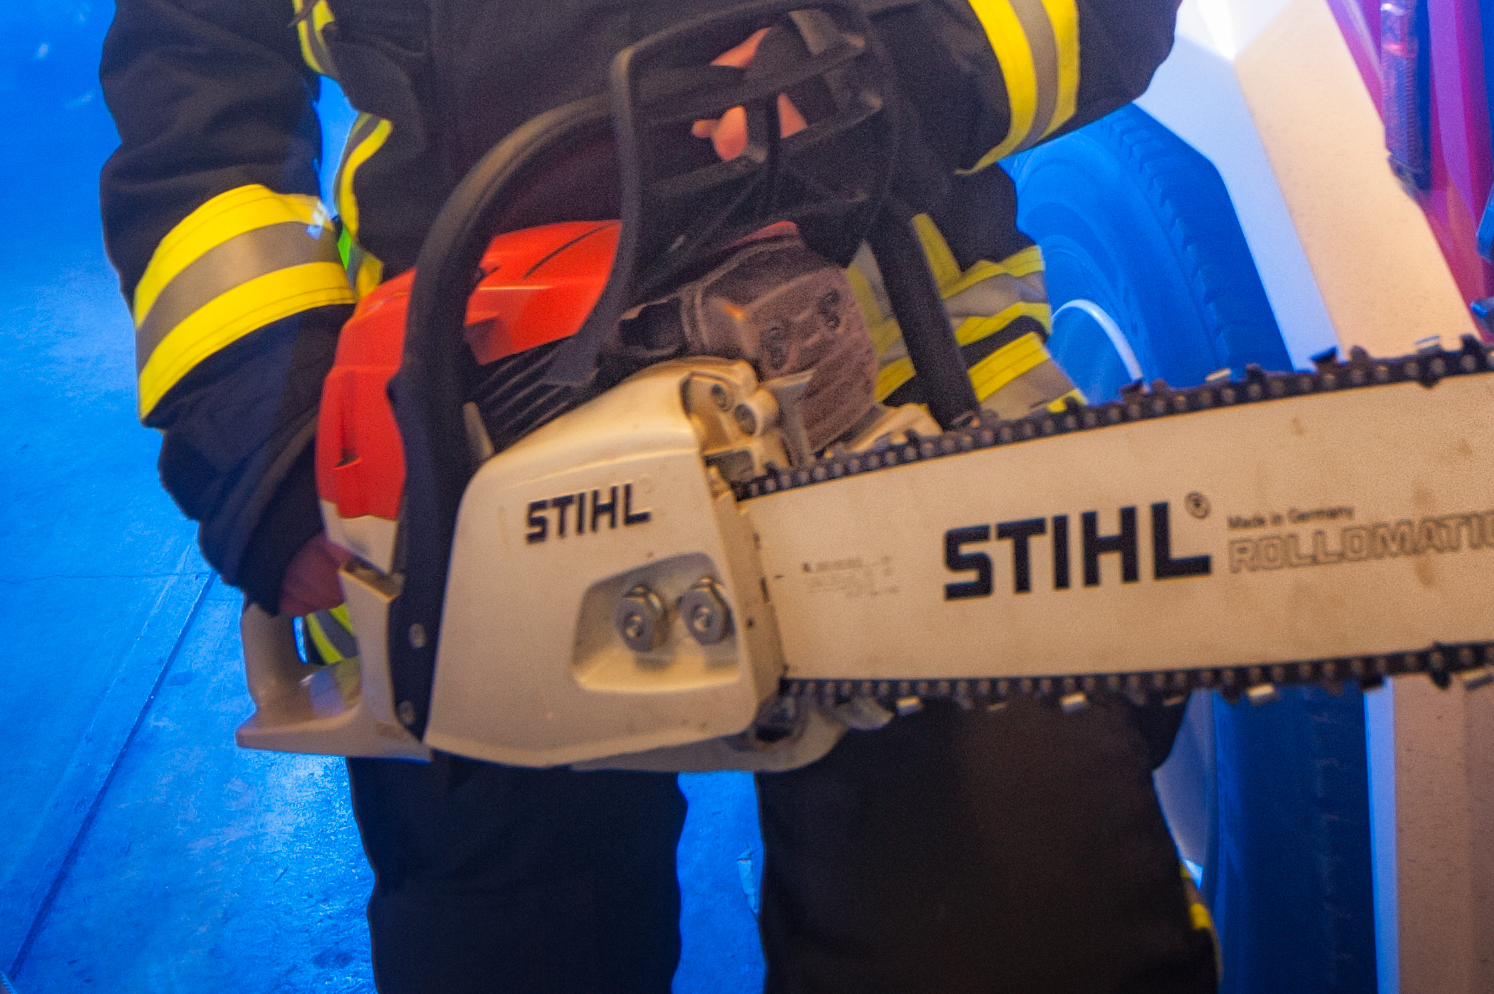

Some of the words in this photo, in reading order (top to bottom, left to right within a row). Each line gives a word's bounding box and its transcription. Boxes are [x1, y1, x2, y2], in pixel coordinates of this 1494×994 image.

[526, 482, 651, 545] STIHL
[1228, 514, 1266, 529] Made
[1270, 511, 1284, 526] in
[1287, 507, 1355, 525] Germany
